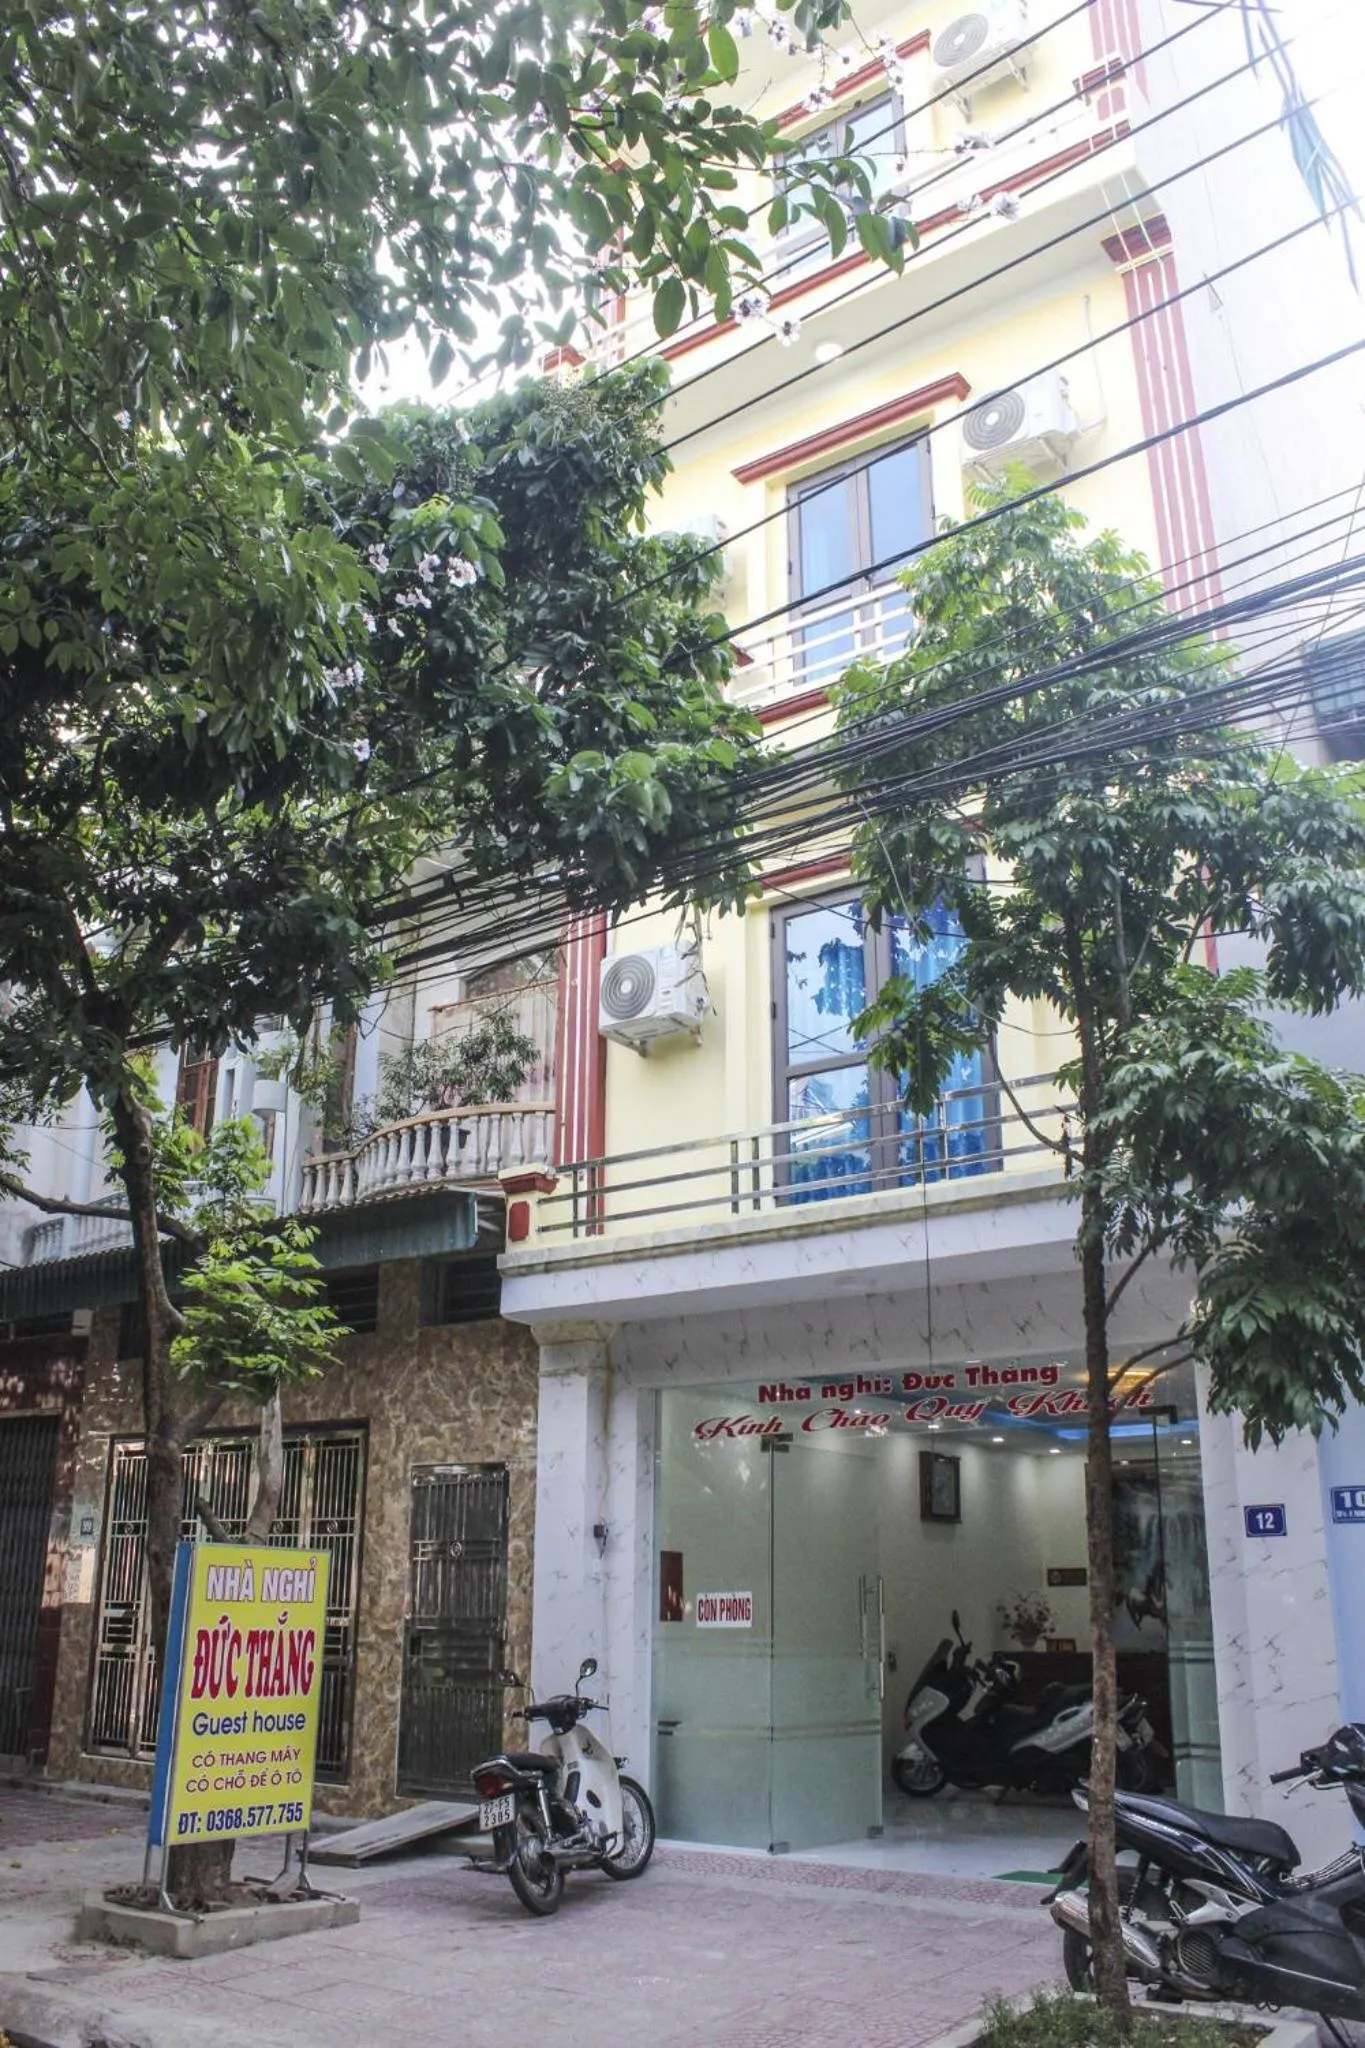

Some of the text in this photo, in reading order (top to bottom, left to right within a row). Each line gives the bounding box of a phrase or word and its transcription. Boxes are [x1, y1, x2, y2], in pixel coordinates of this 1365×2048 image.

[1256, 1511, 1275, 1530] 12
[206, 1557, 317, 1603] NHÀ NGHỈ
[191, 1611, 316, 1699] ĐỨC THẮNG
[192, 1710, 306, 1736] Guest house
[192, 1745, 301, 1768] CÓ THANG MÁY
[186, 1774, 209, 1793] CÓ
[213, 1769, 246, 1791] CHỖ
[250, 1767, 268, 1788] ĐỂ
[177, 1802, 304, 1835] ĐT: 0368.577.755
